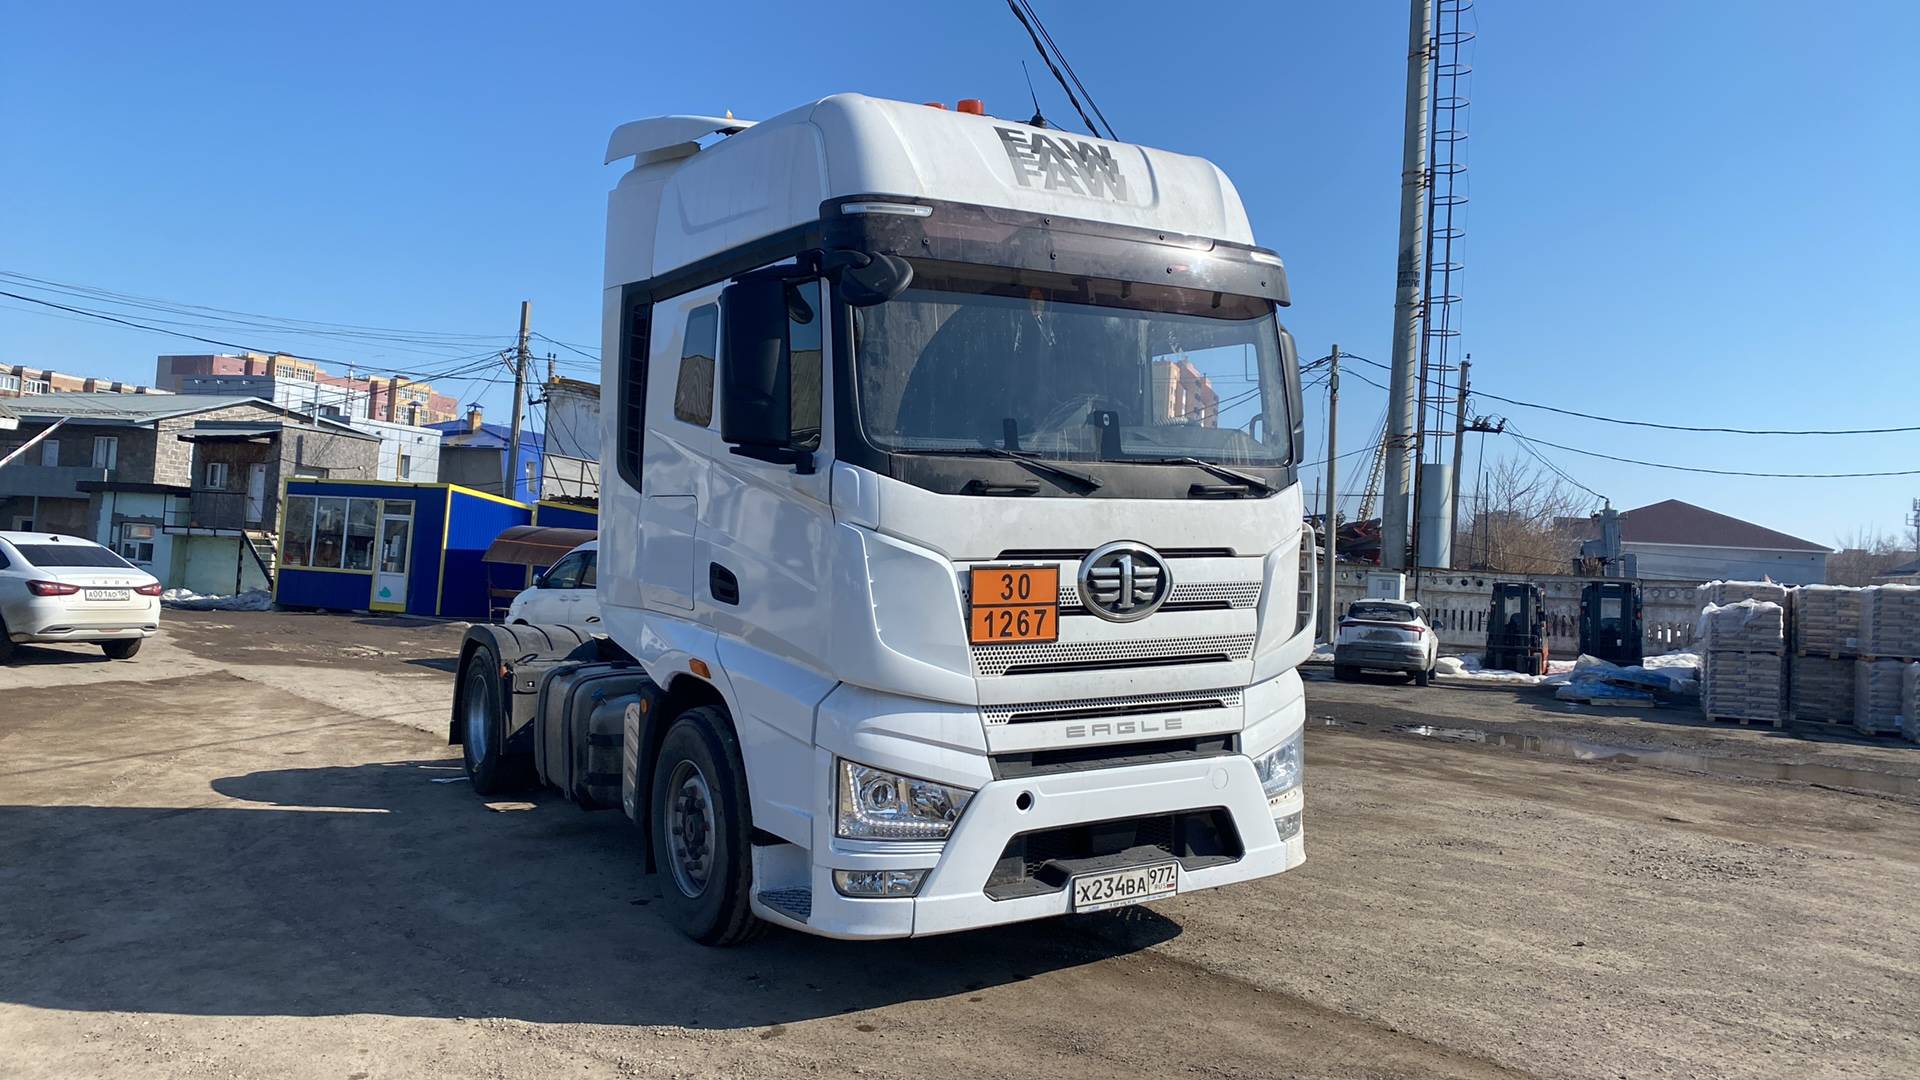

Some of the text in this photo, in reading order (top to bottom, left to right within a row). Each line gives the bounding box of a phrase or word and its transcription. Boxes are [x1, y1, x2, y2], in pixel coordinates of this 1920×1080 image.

[1000, 573, 1031, 601] 30
[984, 608, 1047, 638] 1267
[1065, 718, 1183, 738] EAGLE
